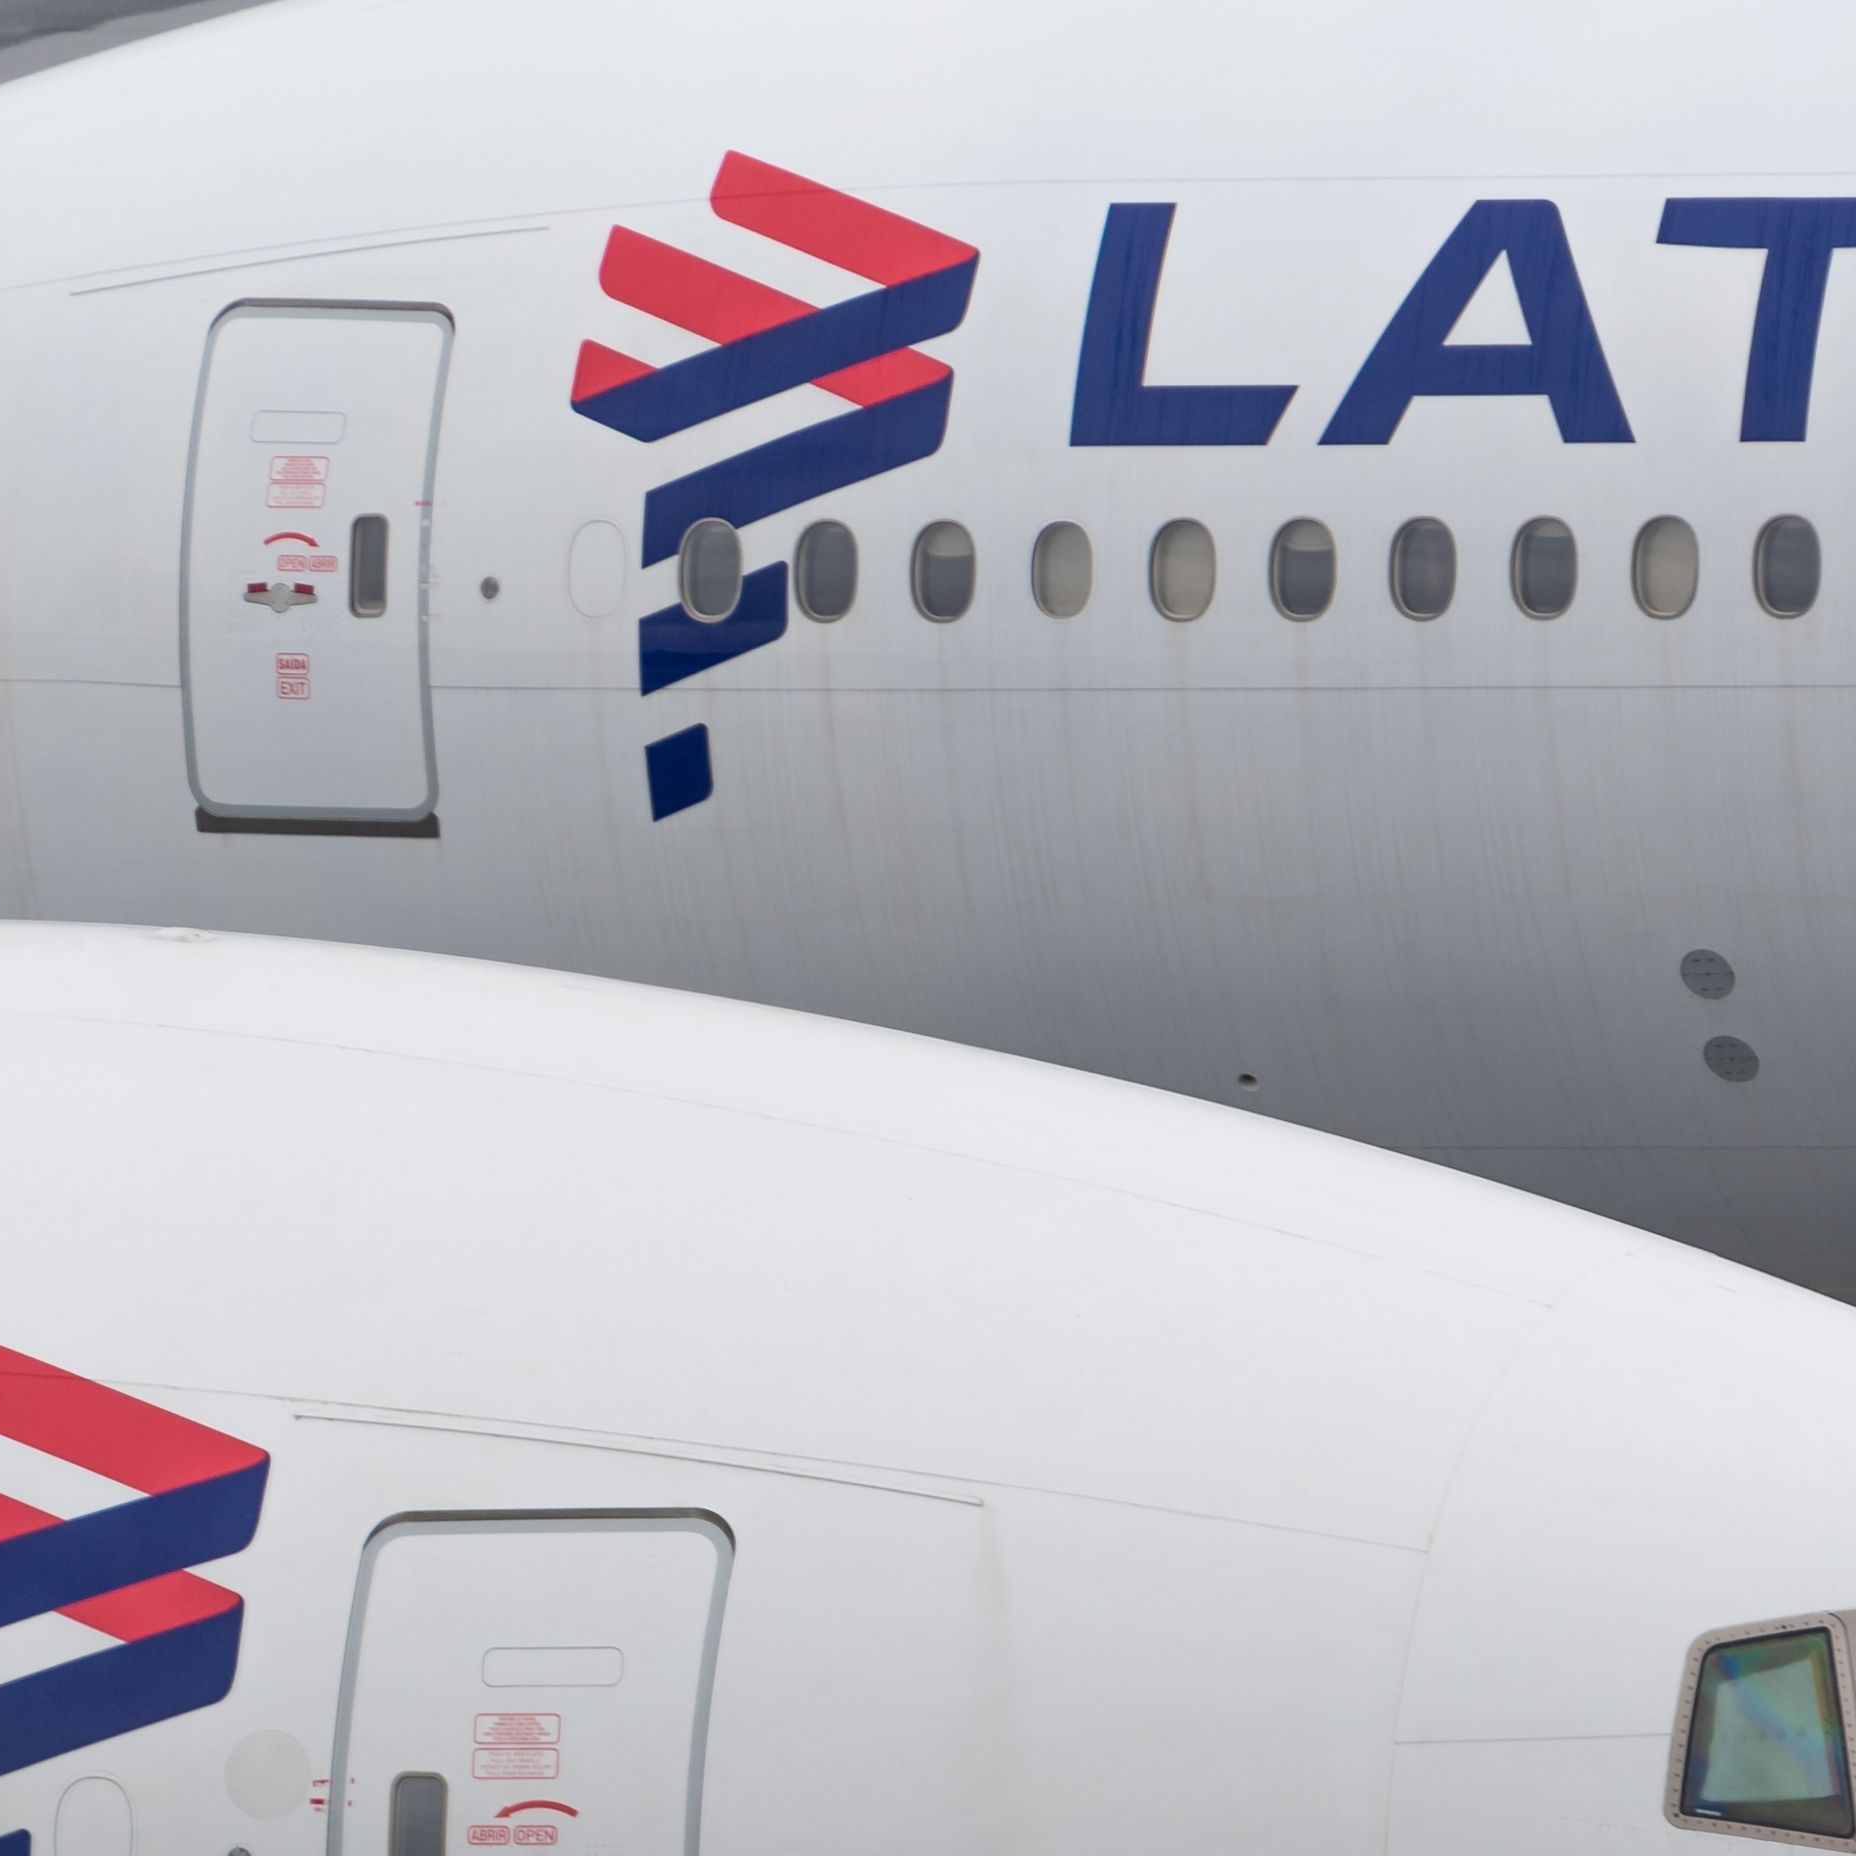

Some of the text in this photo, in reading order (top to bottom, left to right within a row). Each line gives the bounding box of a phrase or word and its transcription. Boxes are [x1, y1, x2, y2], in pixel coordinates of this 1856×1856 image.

[280, 681, 306, 695] EXIT
[471, 1829, 507, 1842] ABRIR
[516, 1829, 555, 1842] OPEN
